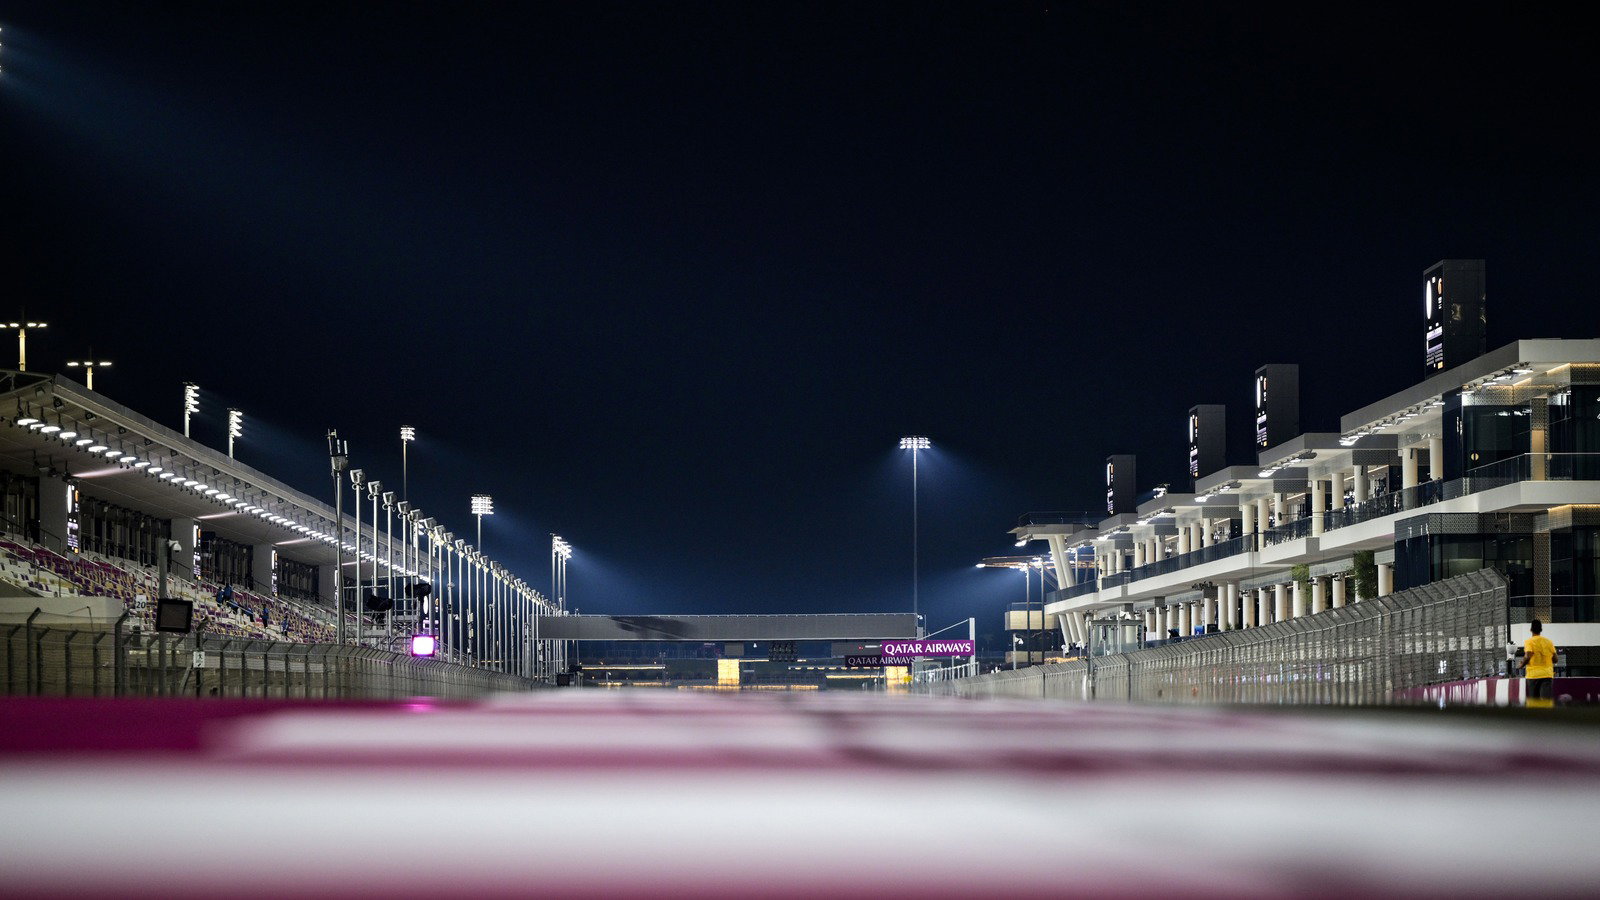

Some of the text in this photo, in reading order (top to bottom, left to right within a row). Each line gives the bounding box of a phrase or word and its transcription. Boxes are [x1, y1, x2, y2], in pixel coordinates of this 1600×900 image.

[136, 601, 146, 609] 20
[885, 643, 971, 655] QATAR AIRWAYS
[848, 657, 878, 666] QATAR
